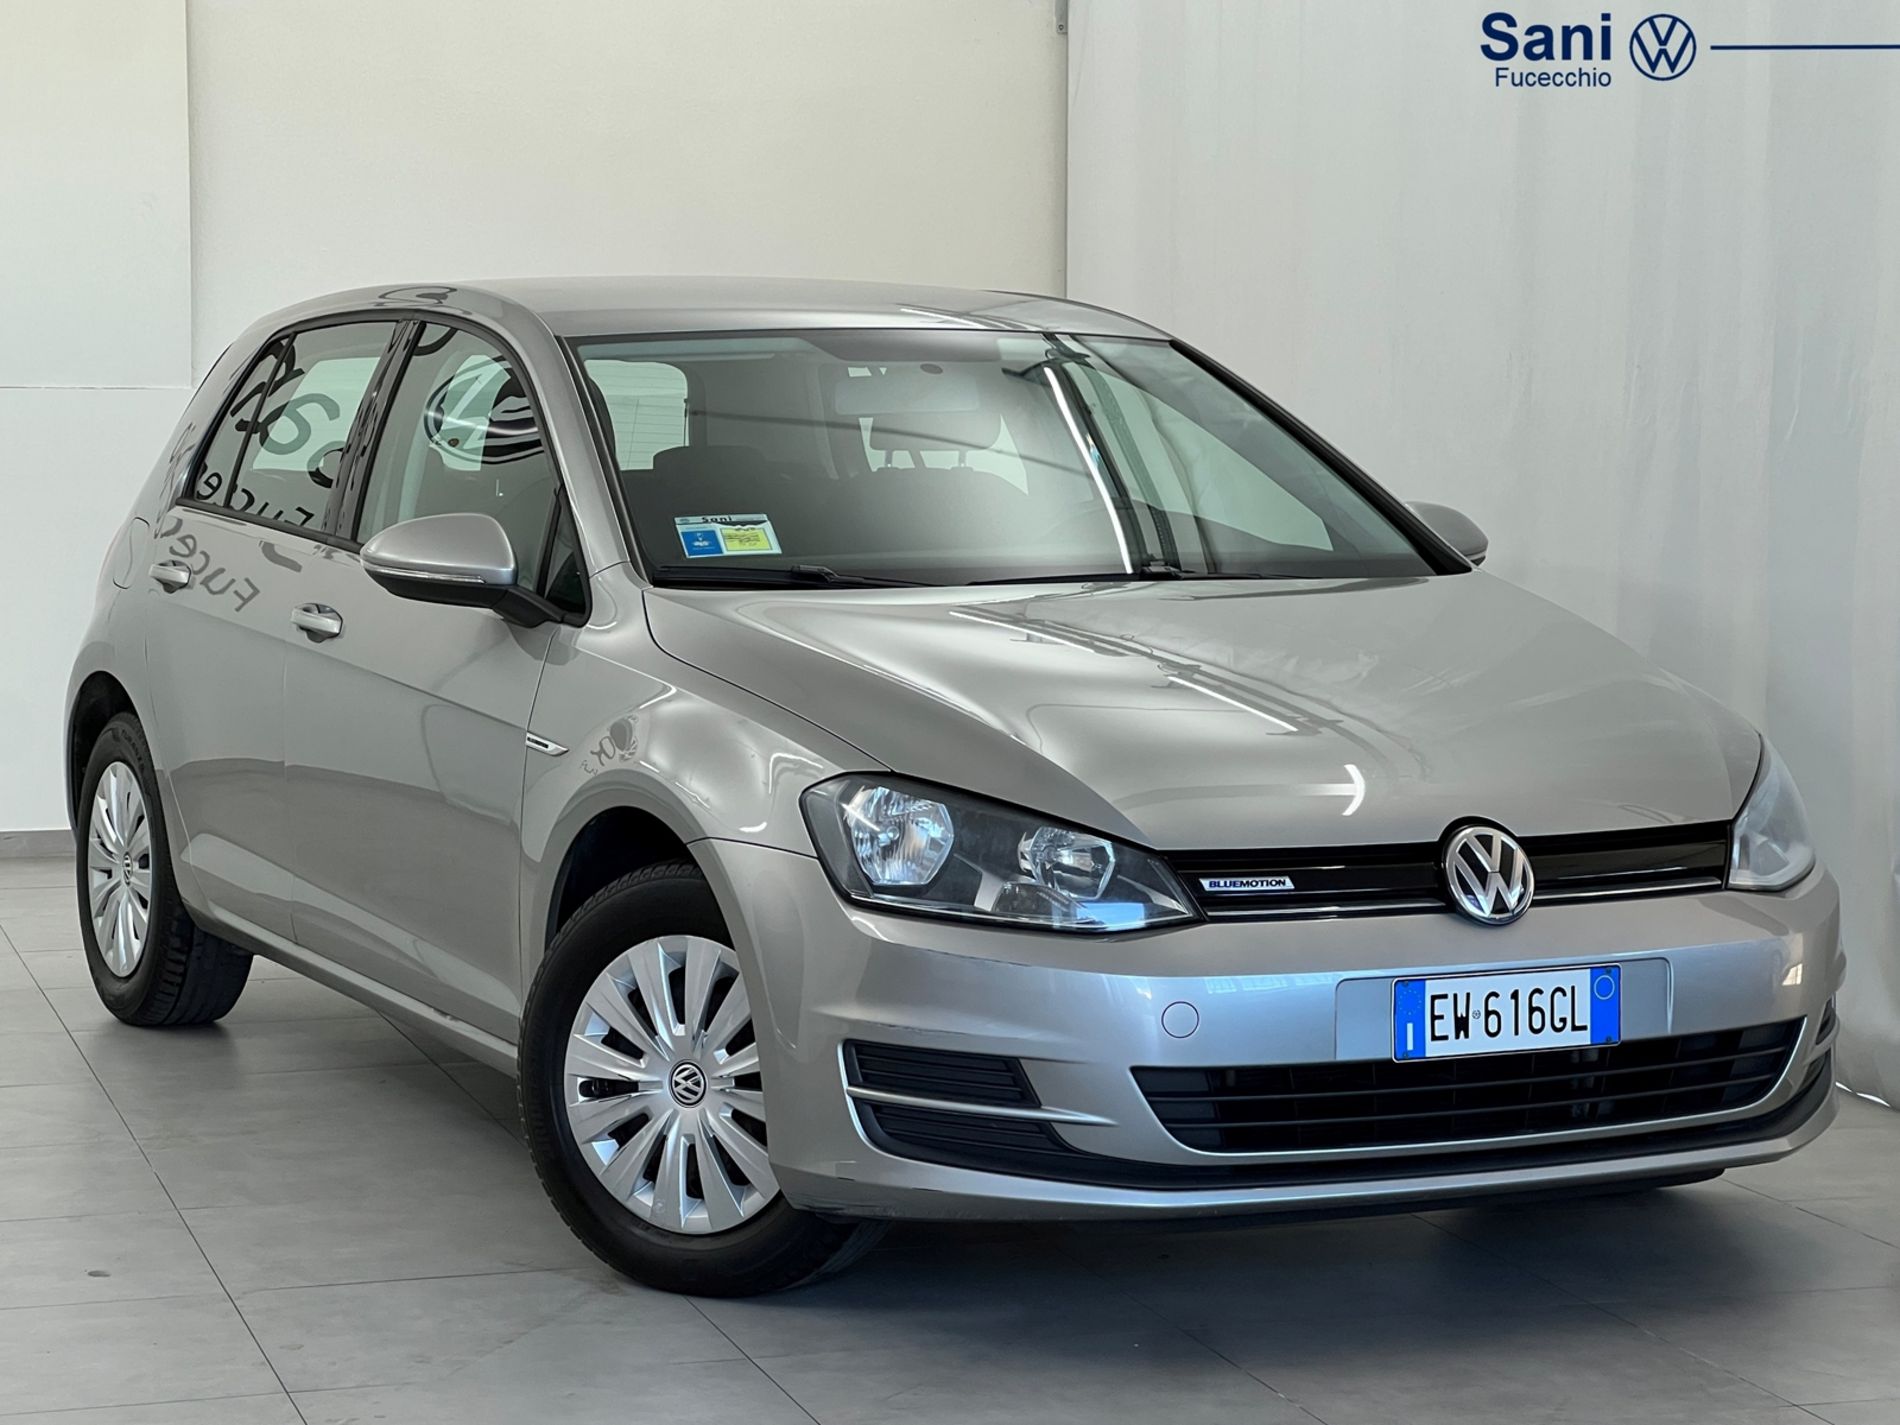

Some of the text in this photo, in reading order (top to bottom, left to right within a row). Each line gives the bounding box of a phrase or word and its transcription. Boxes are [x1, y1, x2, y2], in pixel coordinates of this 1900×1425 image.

[1480, 12, 1612, 61] Sani
[1495, 67, 1612, 88] Fucecchio
[1208, 878, 1287, 890] BLUEMOTION
